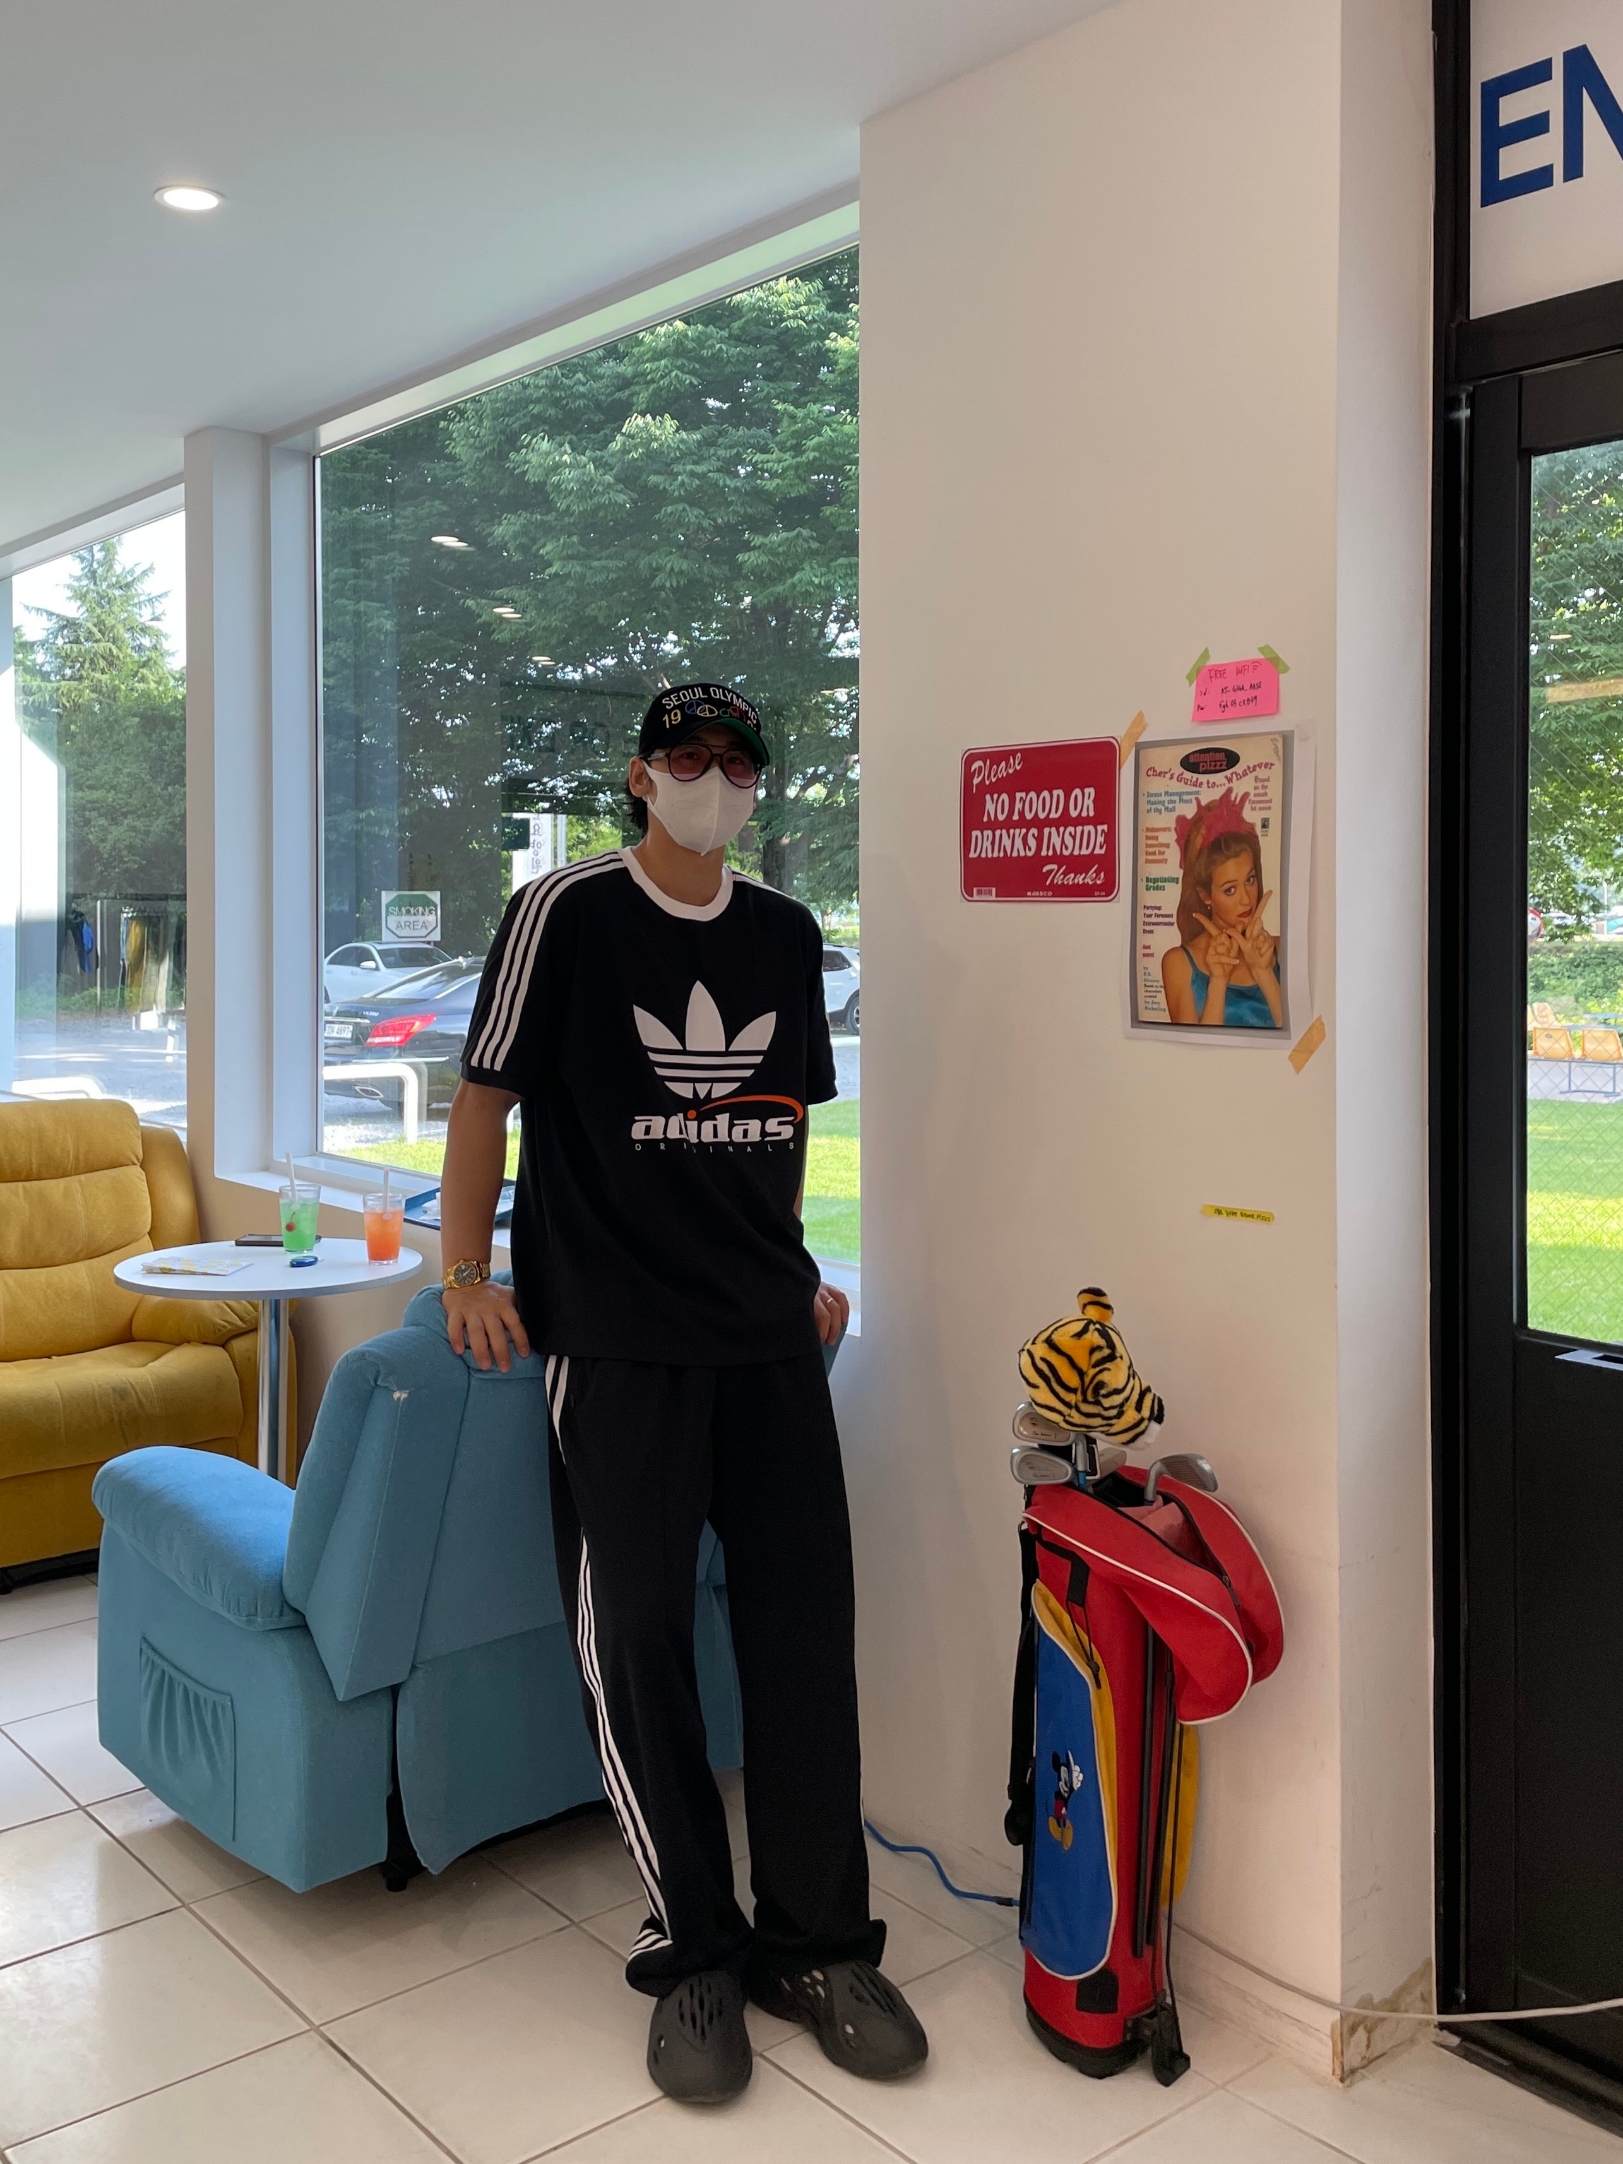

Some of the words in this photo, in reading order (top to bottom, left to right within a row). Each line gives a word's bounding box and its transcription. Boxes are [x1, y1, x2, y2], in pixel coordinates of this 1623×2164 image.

[1208, 668, 1228, 683] FREE
[661, 687, 708, 709] SEOUL
[710, 687, 758, 724] OLYMPIC
[662, 709, 682, 729] 19
[970, 752, 1023, 794] Please
[1146, 766, 1175, 780] Cher's
[1176, 772, 1204, 788] Guide
[1225, 761, 1276, 785] Whatever
[983, 793, 1009, 822] NO
[1012, 789, 1065, 821] FOOD
[1069, 787, 1095, 818] OR
[1146, 799, 1165, 807] Making
[969, 828, 1038, 858] DRINKS
[1041, 824, 1108, 856] INSIDE
[1042, 864, 1105, 886] Thanks
[1145, 876, 1180, 884] Negotiating
[388, 906, 436, 916] SMOKING
[395, 920, 428, 931] AREA
[631, 1110, 796, 1144] adidas
[635, 1142, 795, 1153] ORIINALS
